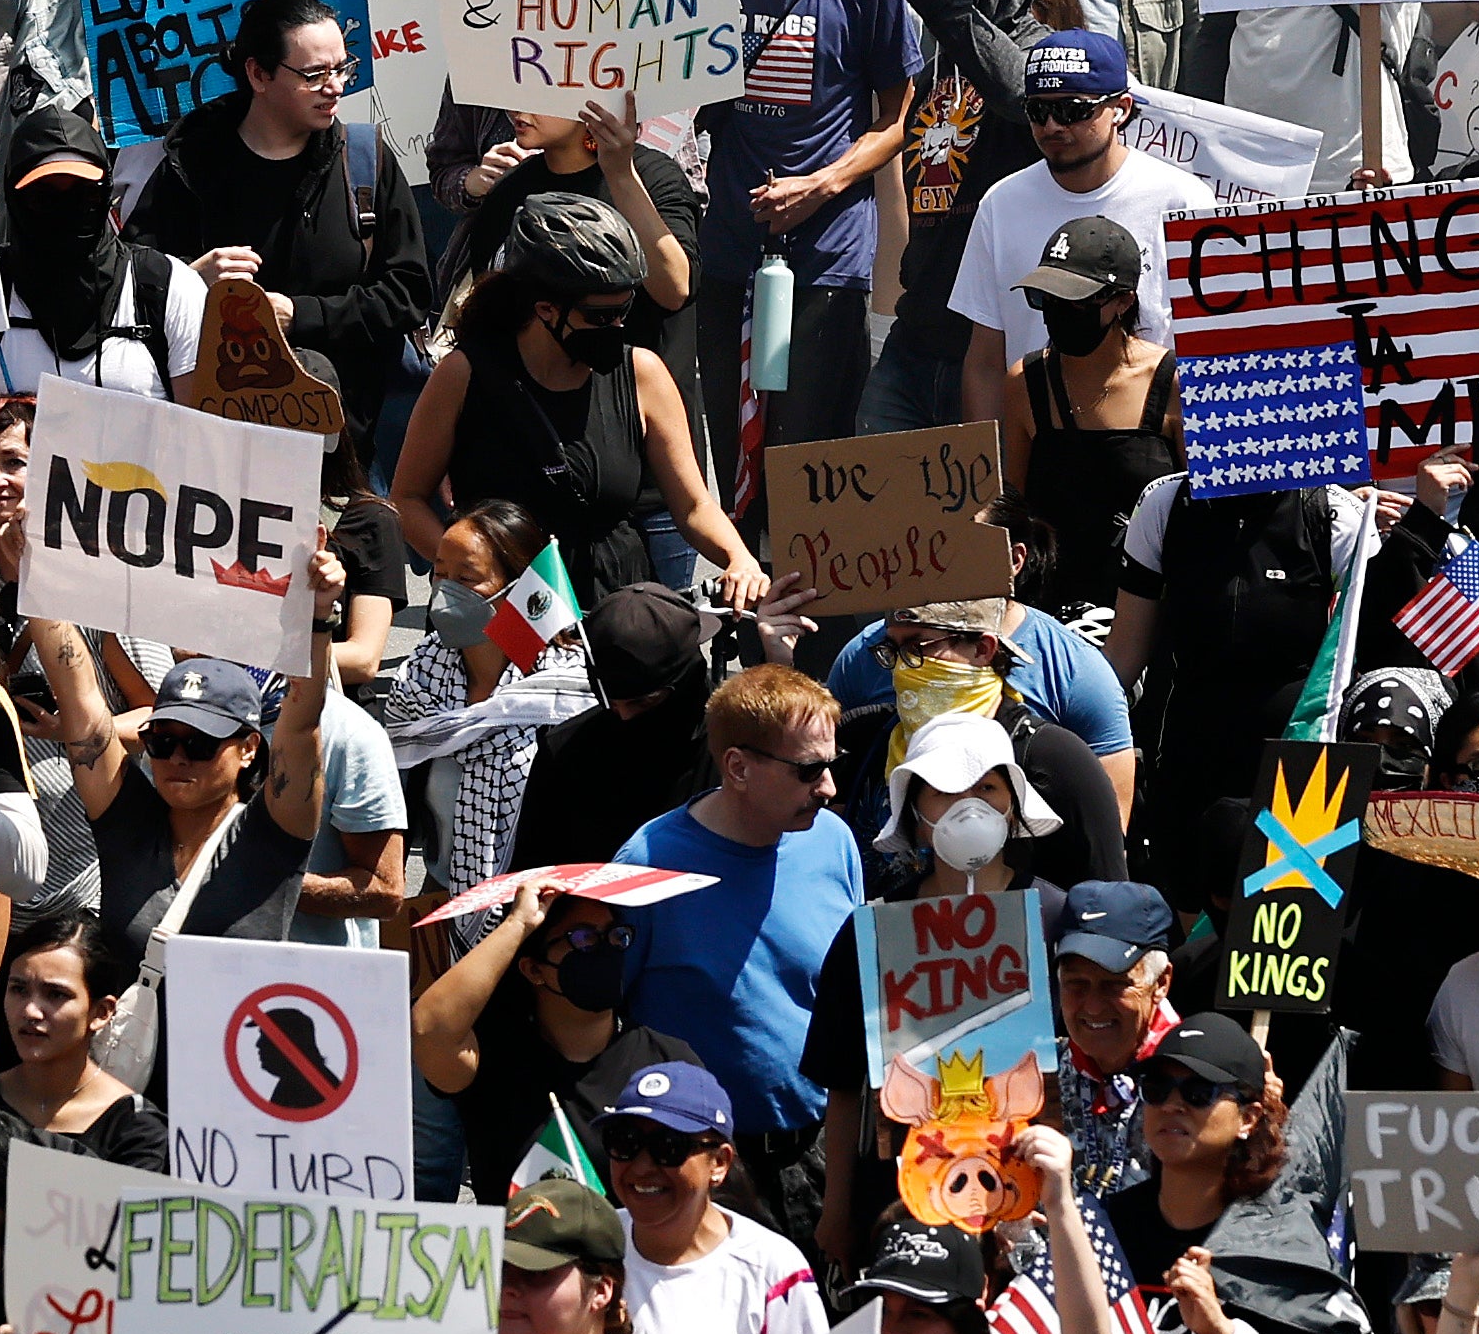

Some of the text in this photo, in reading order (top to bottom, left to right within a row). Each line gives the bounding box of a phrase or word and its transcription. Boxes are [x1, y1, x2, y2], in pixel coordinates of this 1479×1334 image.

[509, 22, 741, 90] RIGHTS
[41, 453, 295, 586] NOPE
[1252, 903, 1301, 945] NO
[1228, 950, 1329, 1002] KINGS
[116, 1197, 499, 1329] FEDERALISM
